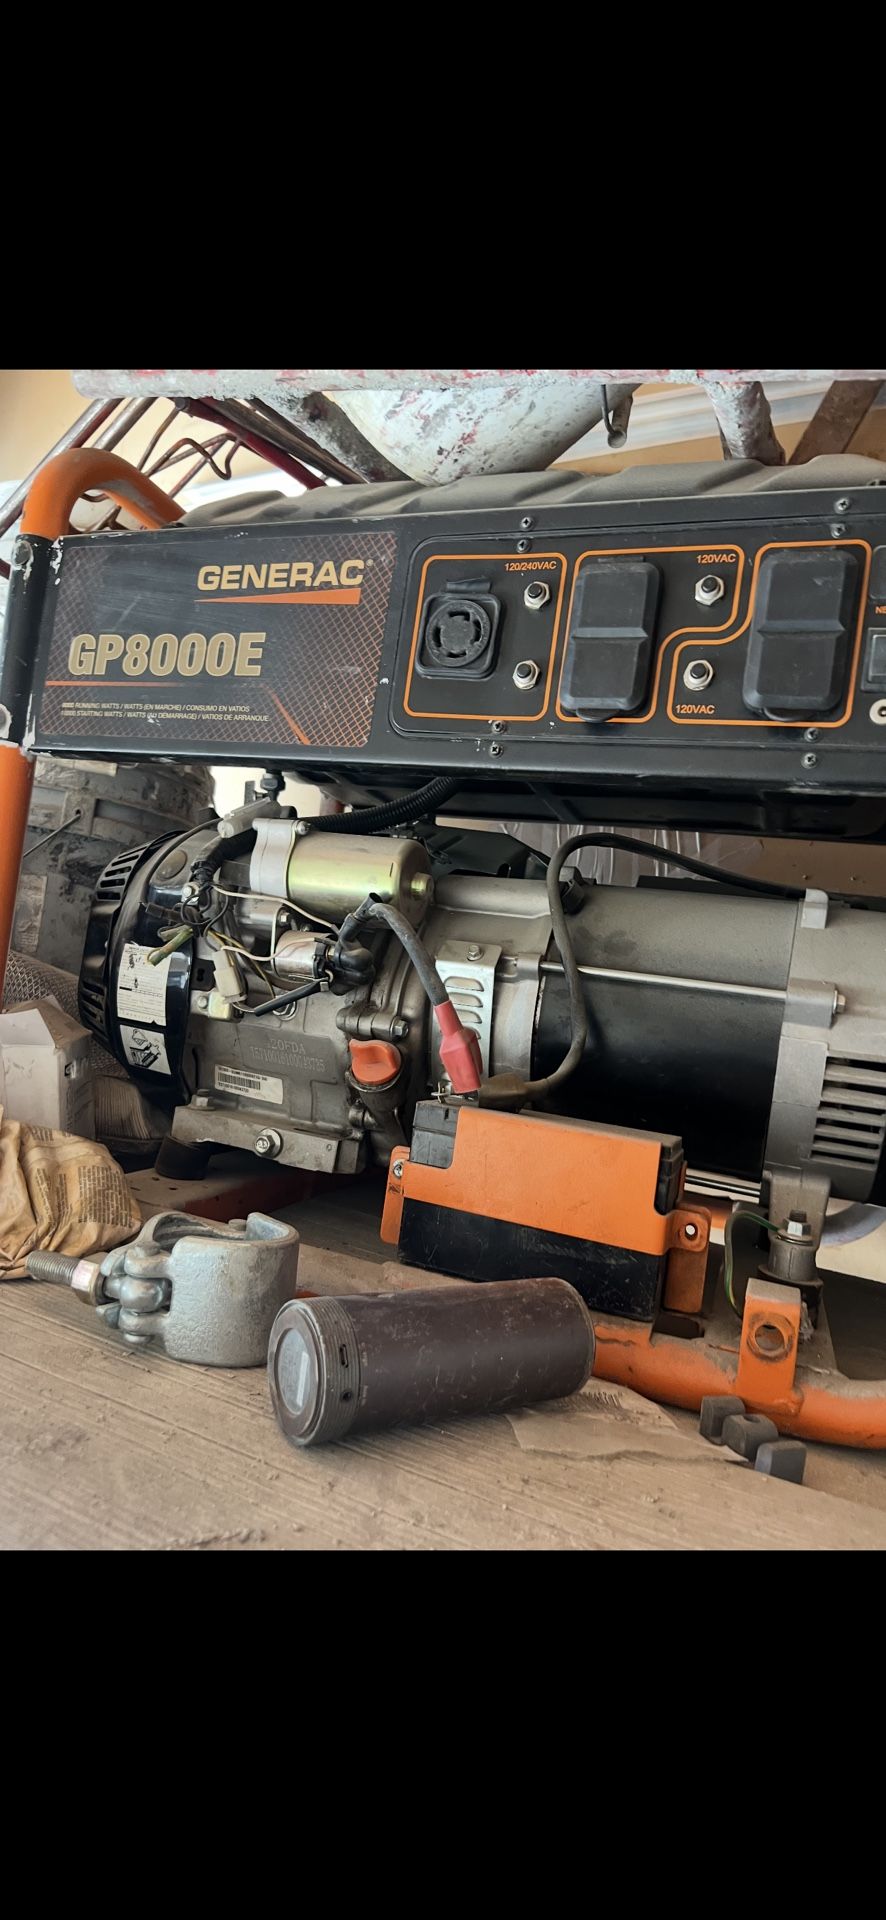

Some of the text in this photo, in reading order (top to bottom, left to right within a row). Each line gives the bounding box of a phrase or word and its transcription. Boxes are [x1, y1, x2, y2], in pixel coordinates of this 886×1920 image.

[696, 553, 736, 564] 120VAC
[505, 560, 557, 571] 120/240VAC
[197, 559, 365, 591] GENERAC
[68, 632, 267, 676] GP8000E
[101, 702, 120, 710] WATTS
[124, 703, 143, 711] WATTS
[143, 703, 154, 711] (EN
[154, 704, 182, 712] MARCHE)
[186, 704, 217, 712] CONSUMO
[228, 705, 250, 713] VATIOS
[675, 704, 715, 715] 120VAC
[127, 711, 146, 719] WATTS
[224, 713, 233, 721] DE
[234, 714, 269, 722] ARRANQUE
